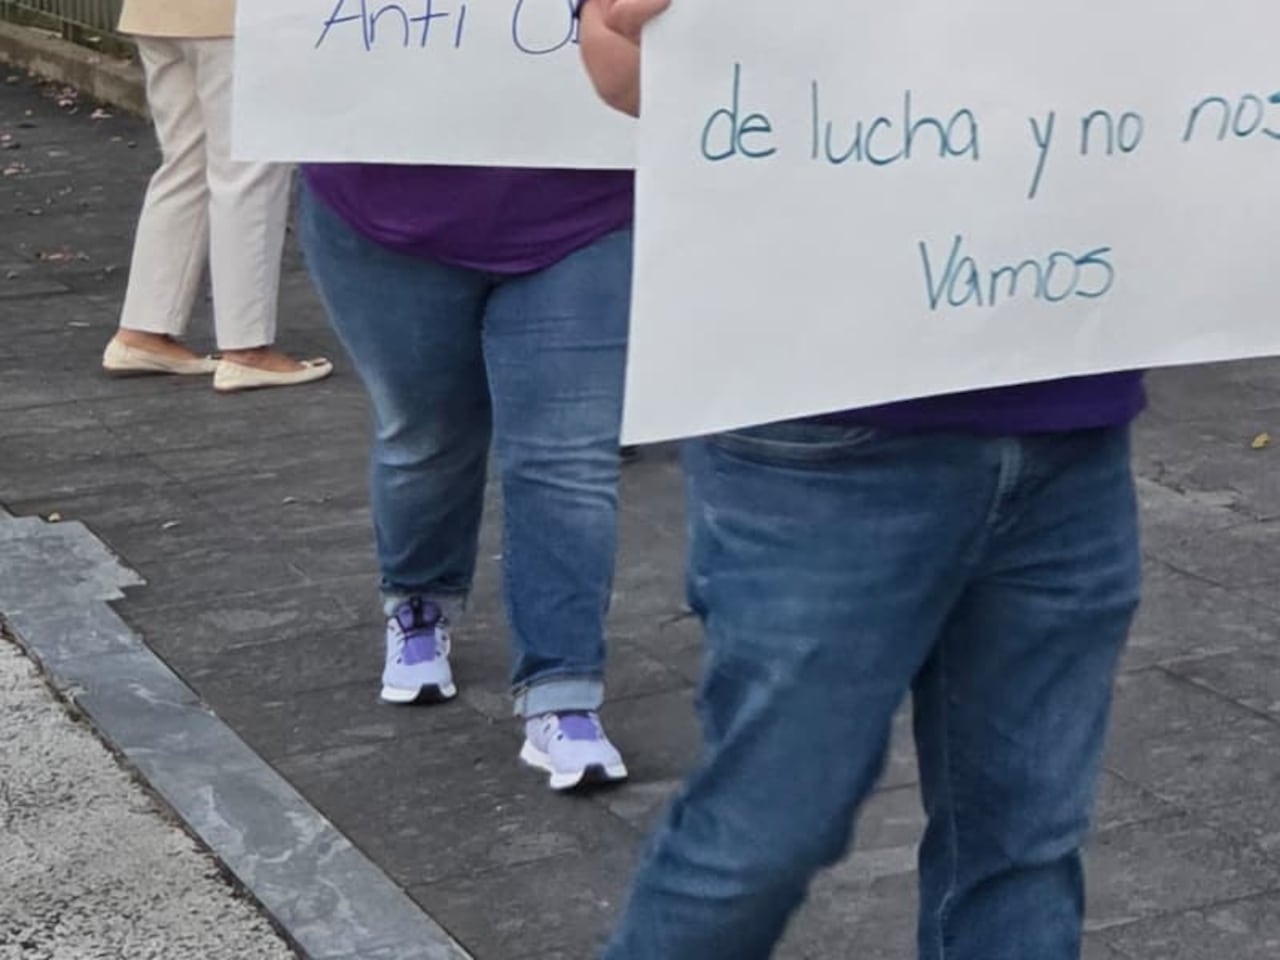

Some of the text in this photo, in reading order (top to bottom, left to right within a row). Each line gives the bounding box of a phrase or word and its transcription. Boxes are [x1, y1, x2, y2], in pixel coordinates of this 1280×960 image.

[699, 62, 778, 162] de
[810, 79, 980, 167] lucha
[1026, 110, 1056, 200] y
[1079, 110, 1145, 156] no
[918, 234, 1116, 312] Vamos
